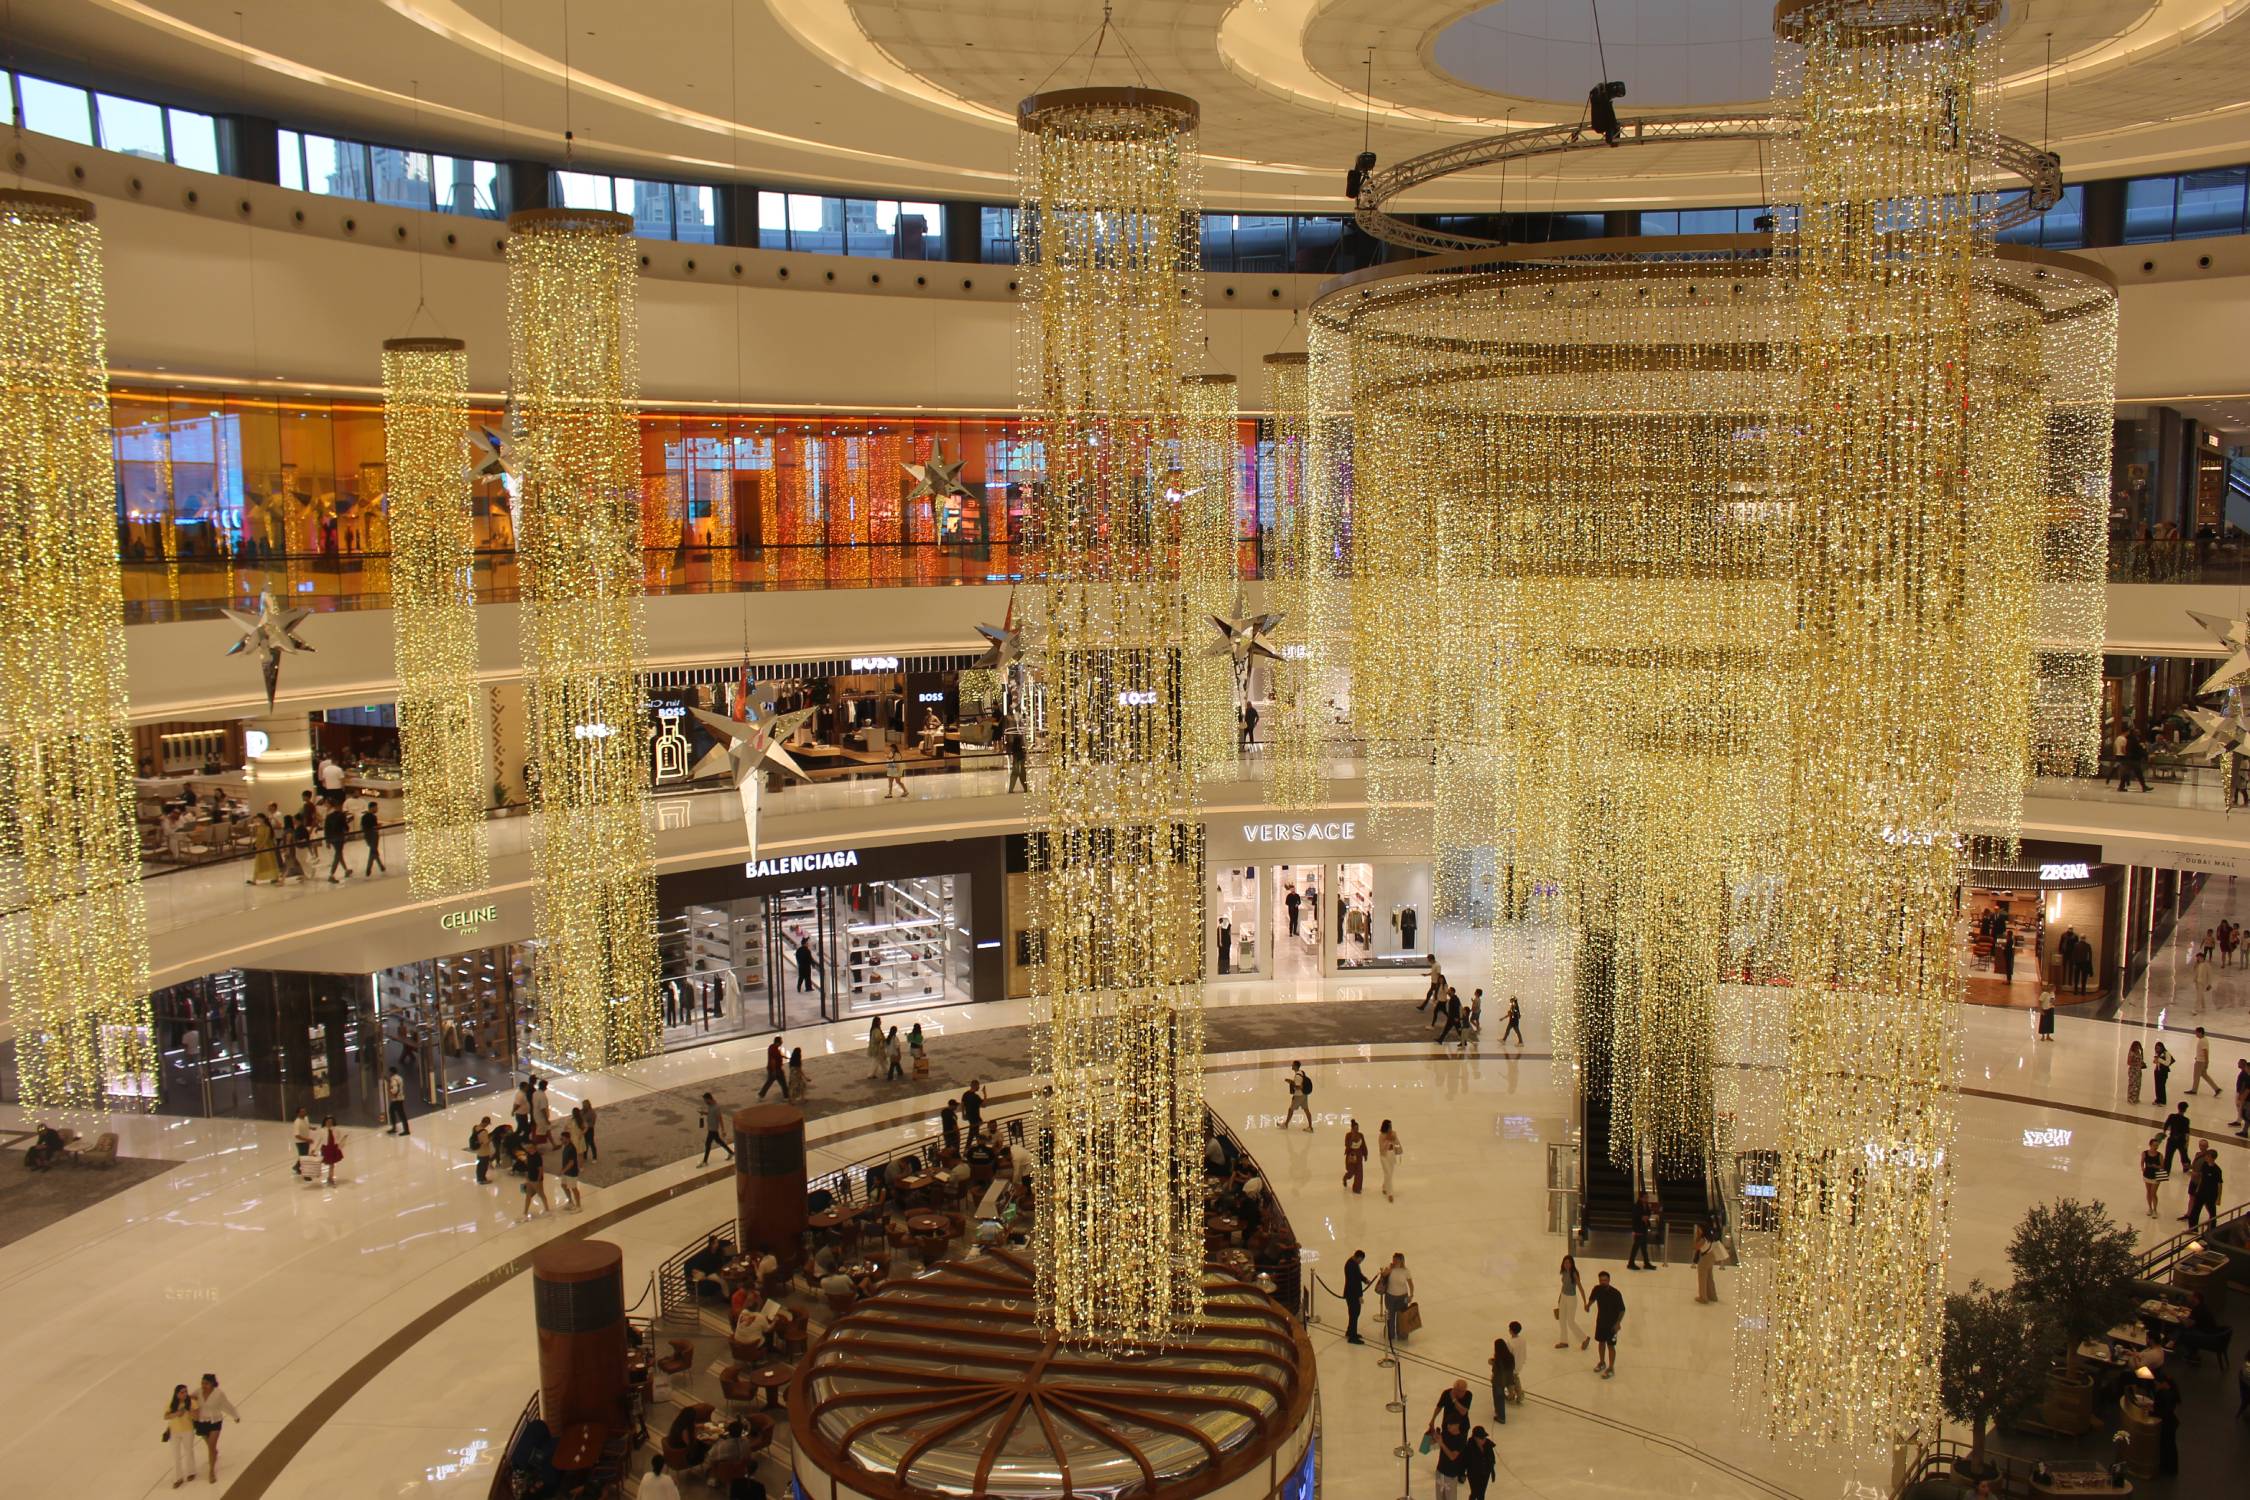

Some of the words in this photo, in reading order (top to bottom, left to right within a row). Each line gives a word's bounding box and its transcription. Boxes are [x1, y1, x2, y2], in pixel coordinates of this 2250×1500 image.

[919, 692, 944, 703] BOSS
[658, 707, 686, 717] BOSS
[1243, 822, 1355, 842] VERSACE
[745, 850, 858, 879] BALENCIAGA
[2039, 863, 2090, 880] ZEGNA
[2185, 857, 2212, 866] DUBAI
[2214, 859, 2236, 869] MALL
[440, 904, 498, 931] CELINE
